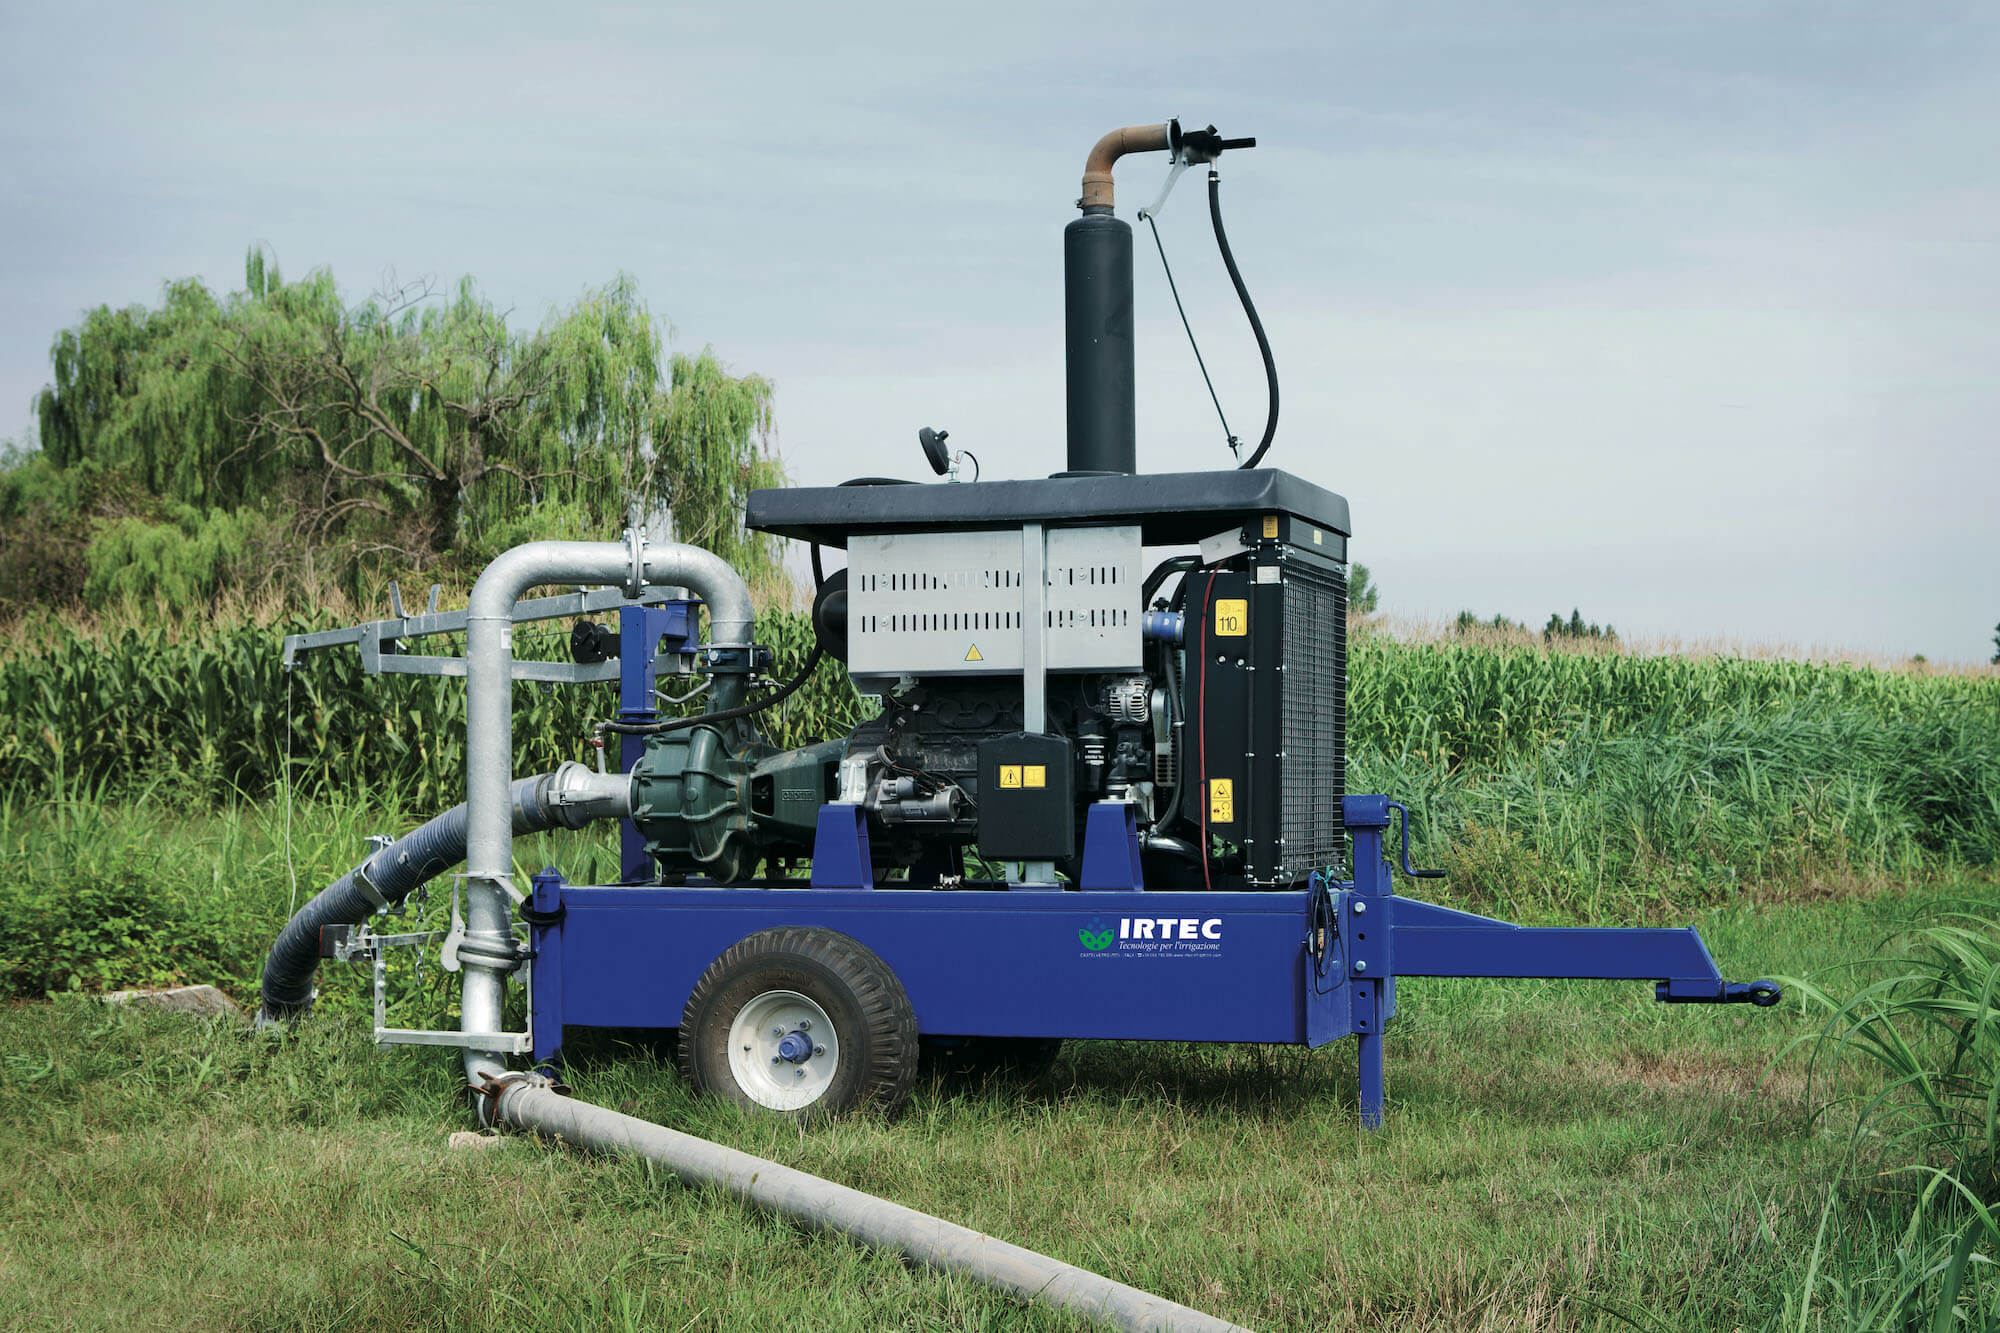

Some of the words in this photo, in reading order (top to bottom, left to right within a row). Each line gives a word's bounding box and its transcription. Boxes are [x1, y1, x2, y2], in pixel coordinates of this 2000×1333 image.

[1219, 616, 1238, 632] 110
[1119, 918, 1222, 940] IRTEC
[1119, 941, 1158, 951] Tecnologie
[1159, 943, 1173, 952] per
[1174, 941, 1220, 951] l'irrigazione
